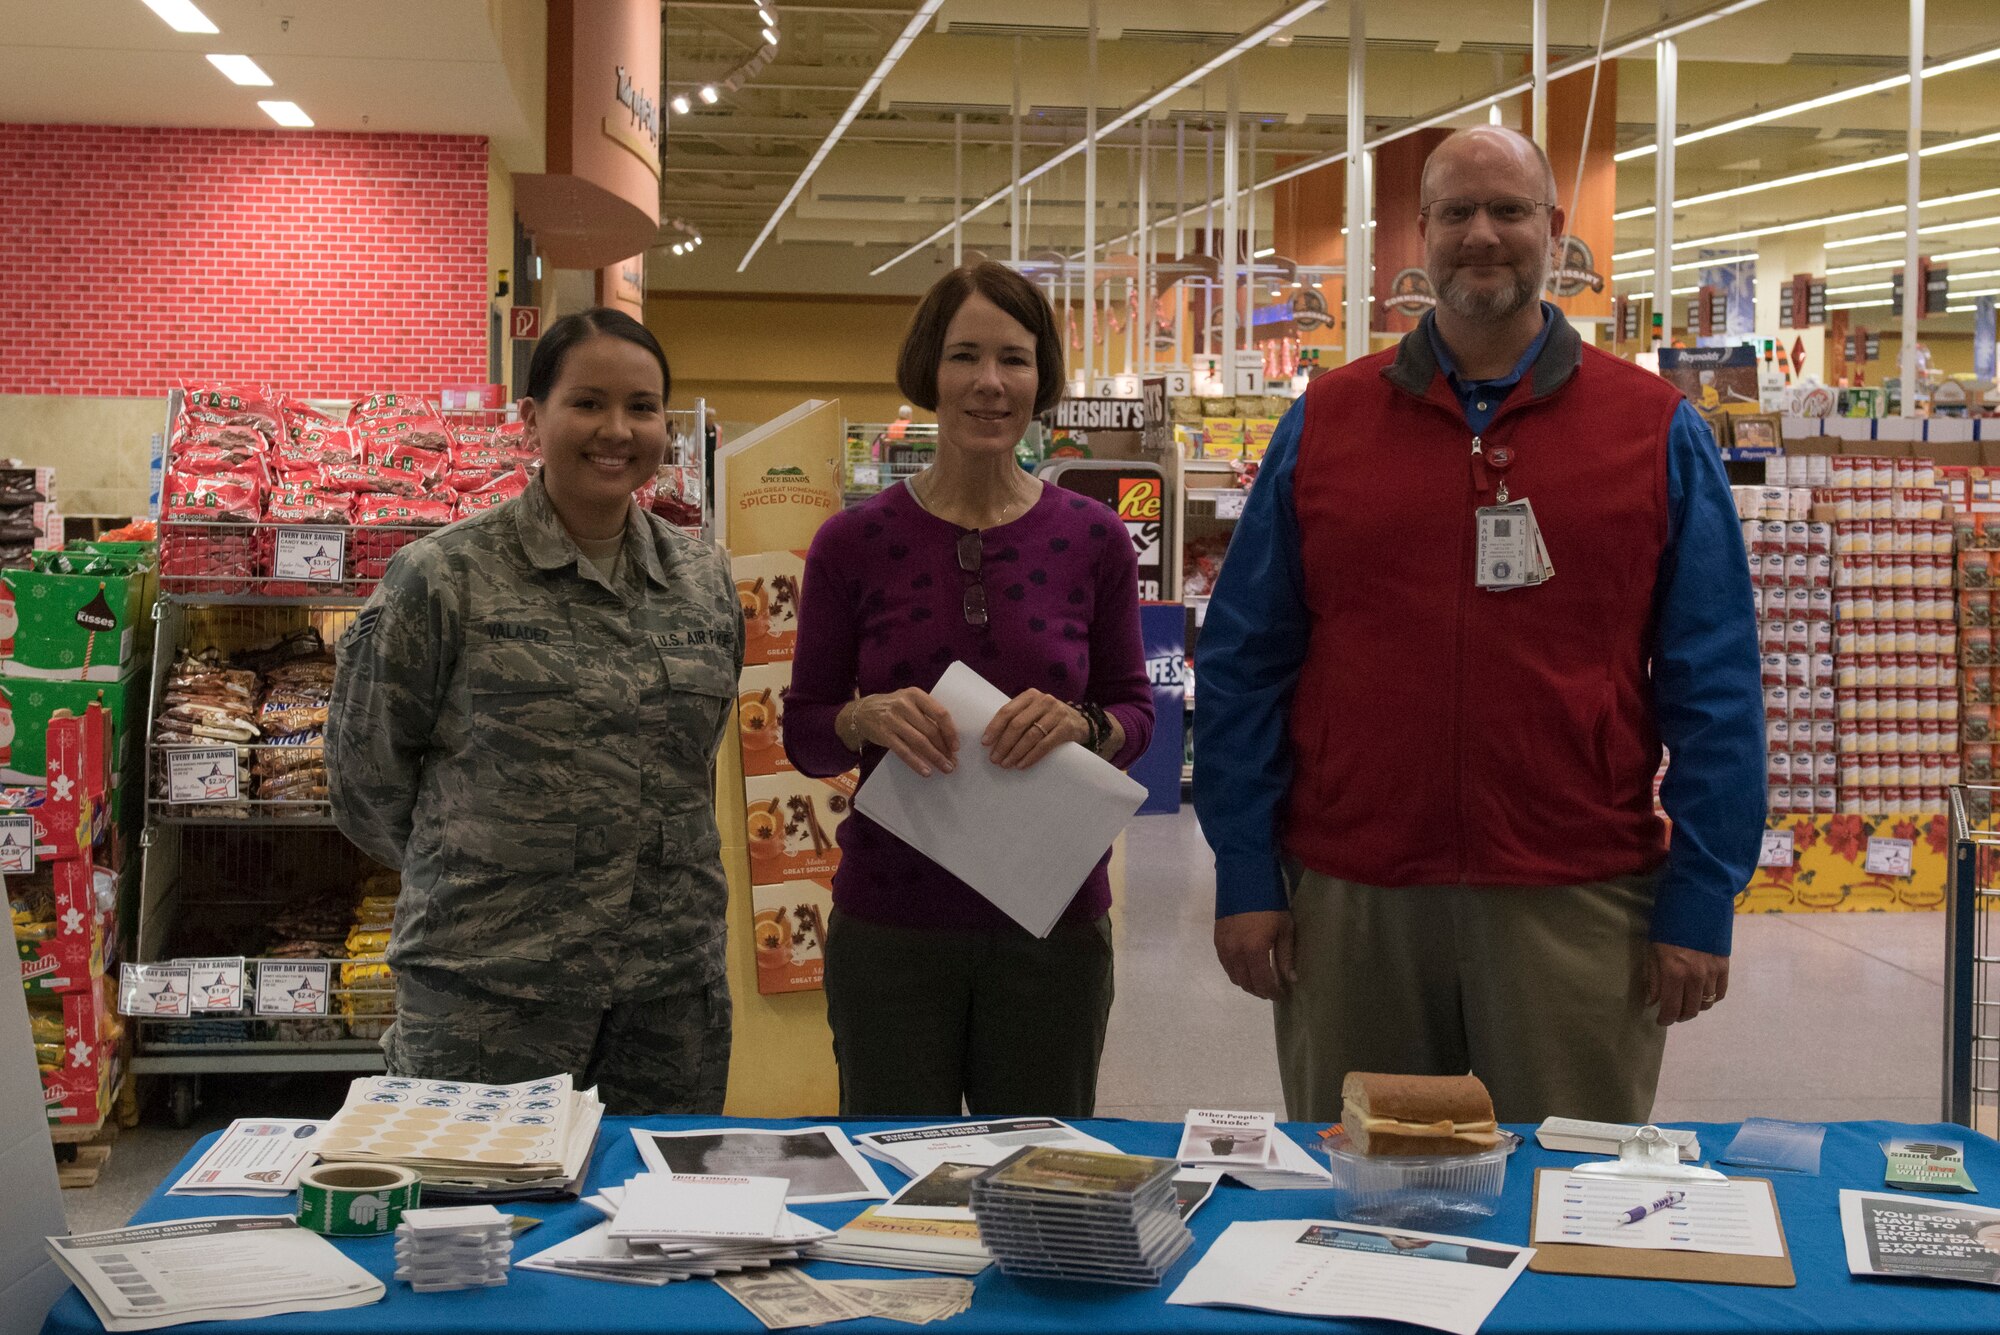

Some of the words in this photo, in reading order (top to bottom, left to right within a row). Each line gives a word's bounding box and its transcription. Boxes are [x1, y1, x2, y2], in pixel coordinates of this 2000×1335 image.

[1384, 294, 1437, 307] COMMISSAR
[1679, 352, 1720, 363] Reynolds
[1125, 382, 1134, 394] 5
[1174, 377, 1184, 392] 3
[1247, 373, 1255, 390] 1
[1102, 383, 1111, 396] 6
[1056, 400, 1144, 429] HERSHEY'S
[368, 453, 421, 472] BRACH'S
[761, 476, 779, 484] SPICE
[782, 476, 810, 484] ISLANDS
[743, 488, 762, 497] MAKE
[787, 486, 828, 496] HOMEMADE
[171, 492, 227, 509] BRACH'S
[740, 494, 787, 510] SPICED
[791, 494, 831, 508] CIDER
[280, 531, 299, 539] EVERY
[313, 534, 340, 542] SAVINGS
[488, 623, 549, 643] VALADEZ
[658, 634, 684, 647] U.S.
[687, 631, 707, 645] AIR
[192, 752, 205, 760] DAY
[206, 751, 233, 759] SAVINGS
[838, 775, 857, 790] FREE
[0, 819, 29, 828] SAVINGS
[1, 848, 20, 856] $2.98
[21, 954, 57, 977] Ruth
[44, 1084, 66, 1100] uth
[1198, 1111, 1224, 1119] Other
[1227, 1113, 1265, 1121] People's
[1872, 1209, 1912, 1219] YOU
[1918, 1214, 1979, 1226] DON'T
[1874, 1217, 1921, 1226] HAVE
[1930, 1222, 1957, 1230] TO
[73, 1234, 123, 1242] THINKING
[125, 1228, 159, 1237] ABOUT
[163, 1222, 218, 1232] QUITTING?
[1876, 1230, 1969, 1239] SMOKING
[1320, 1242, 1357, 1250] everyone
[1324, 1238, 1358, 1246] smoking
[1922, 1250, 1972, 1258] ONE.
[1945, 1245, 2000, 1254] WITH
